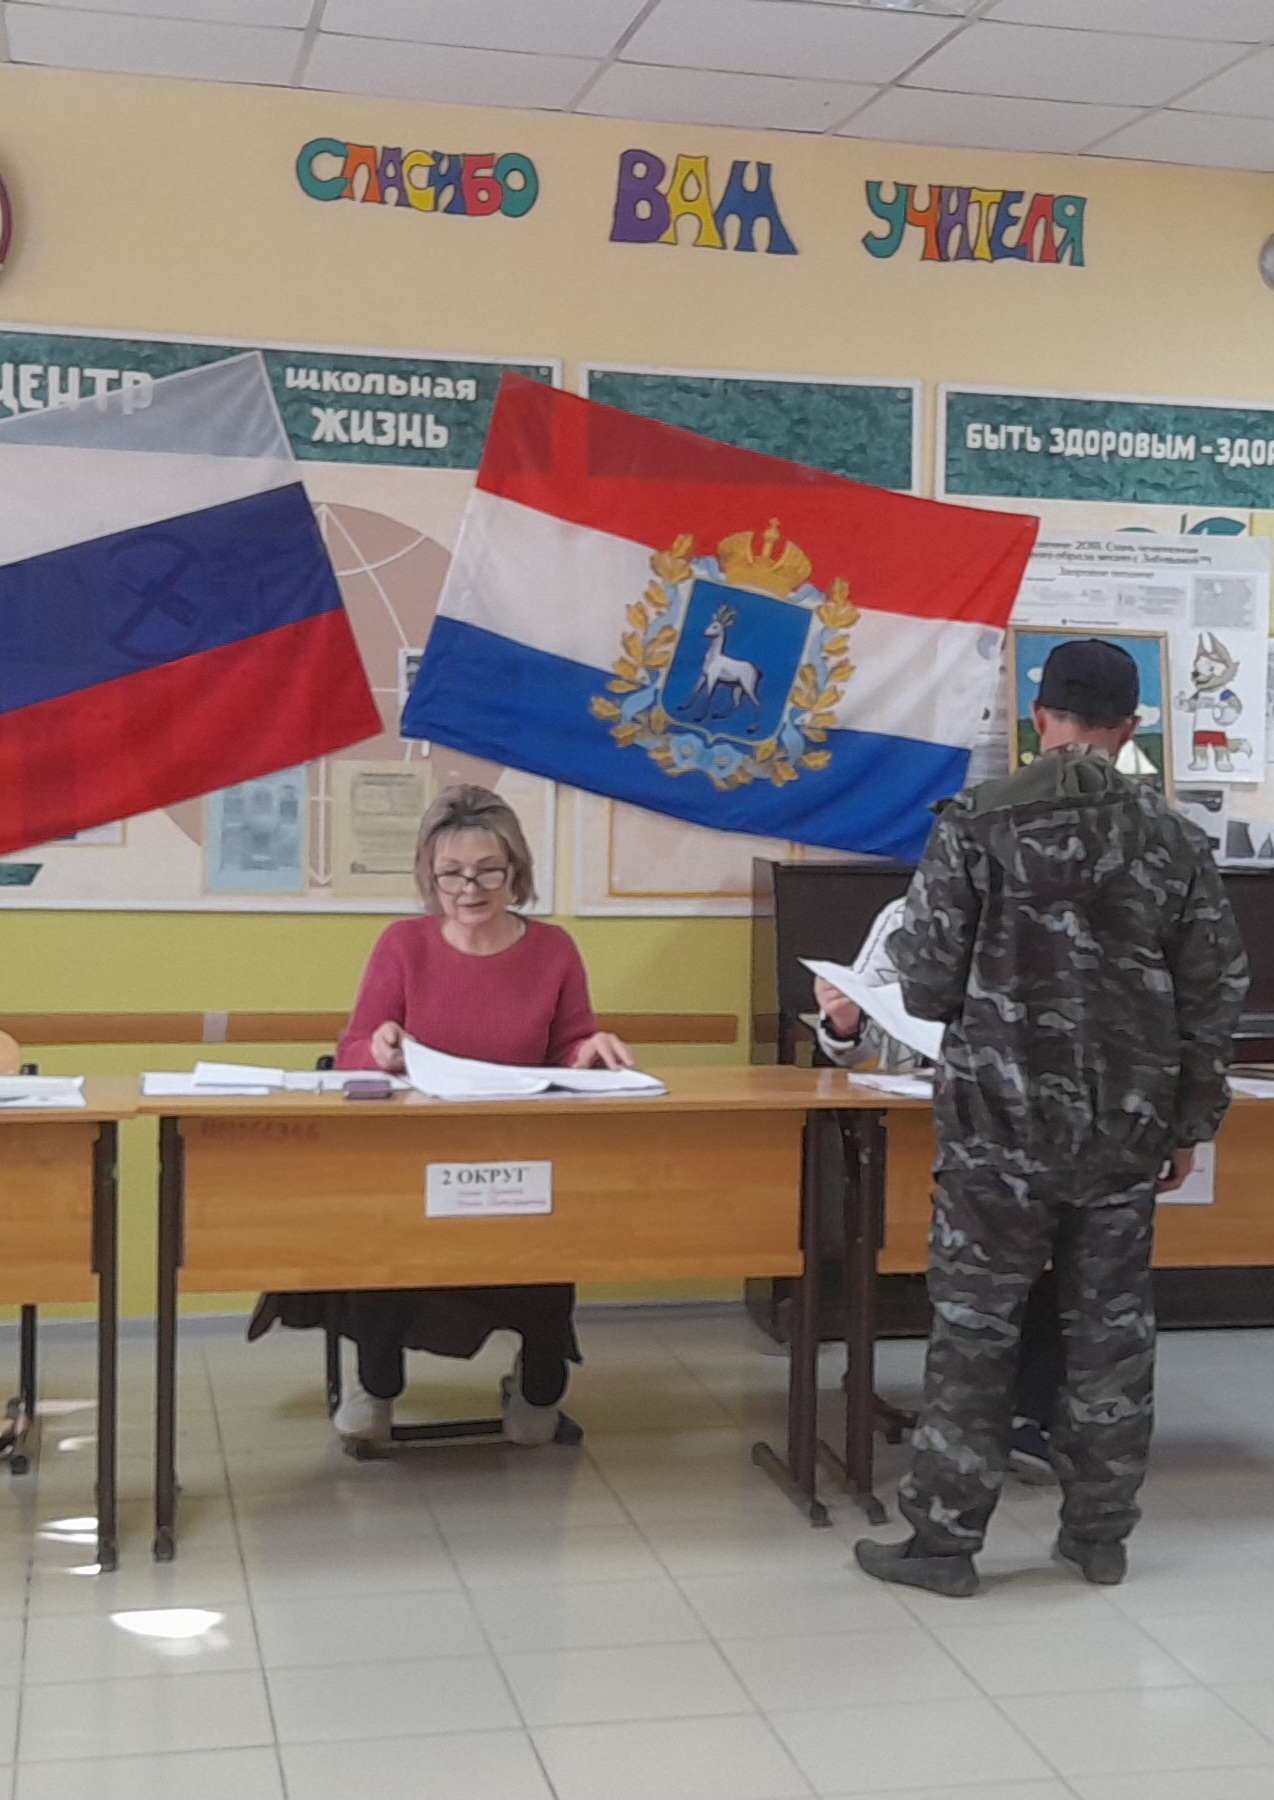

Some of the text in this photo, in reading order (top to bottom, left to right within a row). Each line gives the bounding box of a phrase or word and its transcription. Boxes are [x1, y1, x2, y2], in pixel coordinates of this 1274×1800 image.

[295, 137, 1088, 268] СПАСИБО ВАМ УЧИТЕЛЯ
[311, 406, 449, 449] ЖИЗНЬ
[965, 422, 1042, 453] БЫТЬ
[1048, 426, 1196, 463] ЗДОРОВЫМ
[441, 1166, 530, 1186] 2 ОКРУГ
